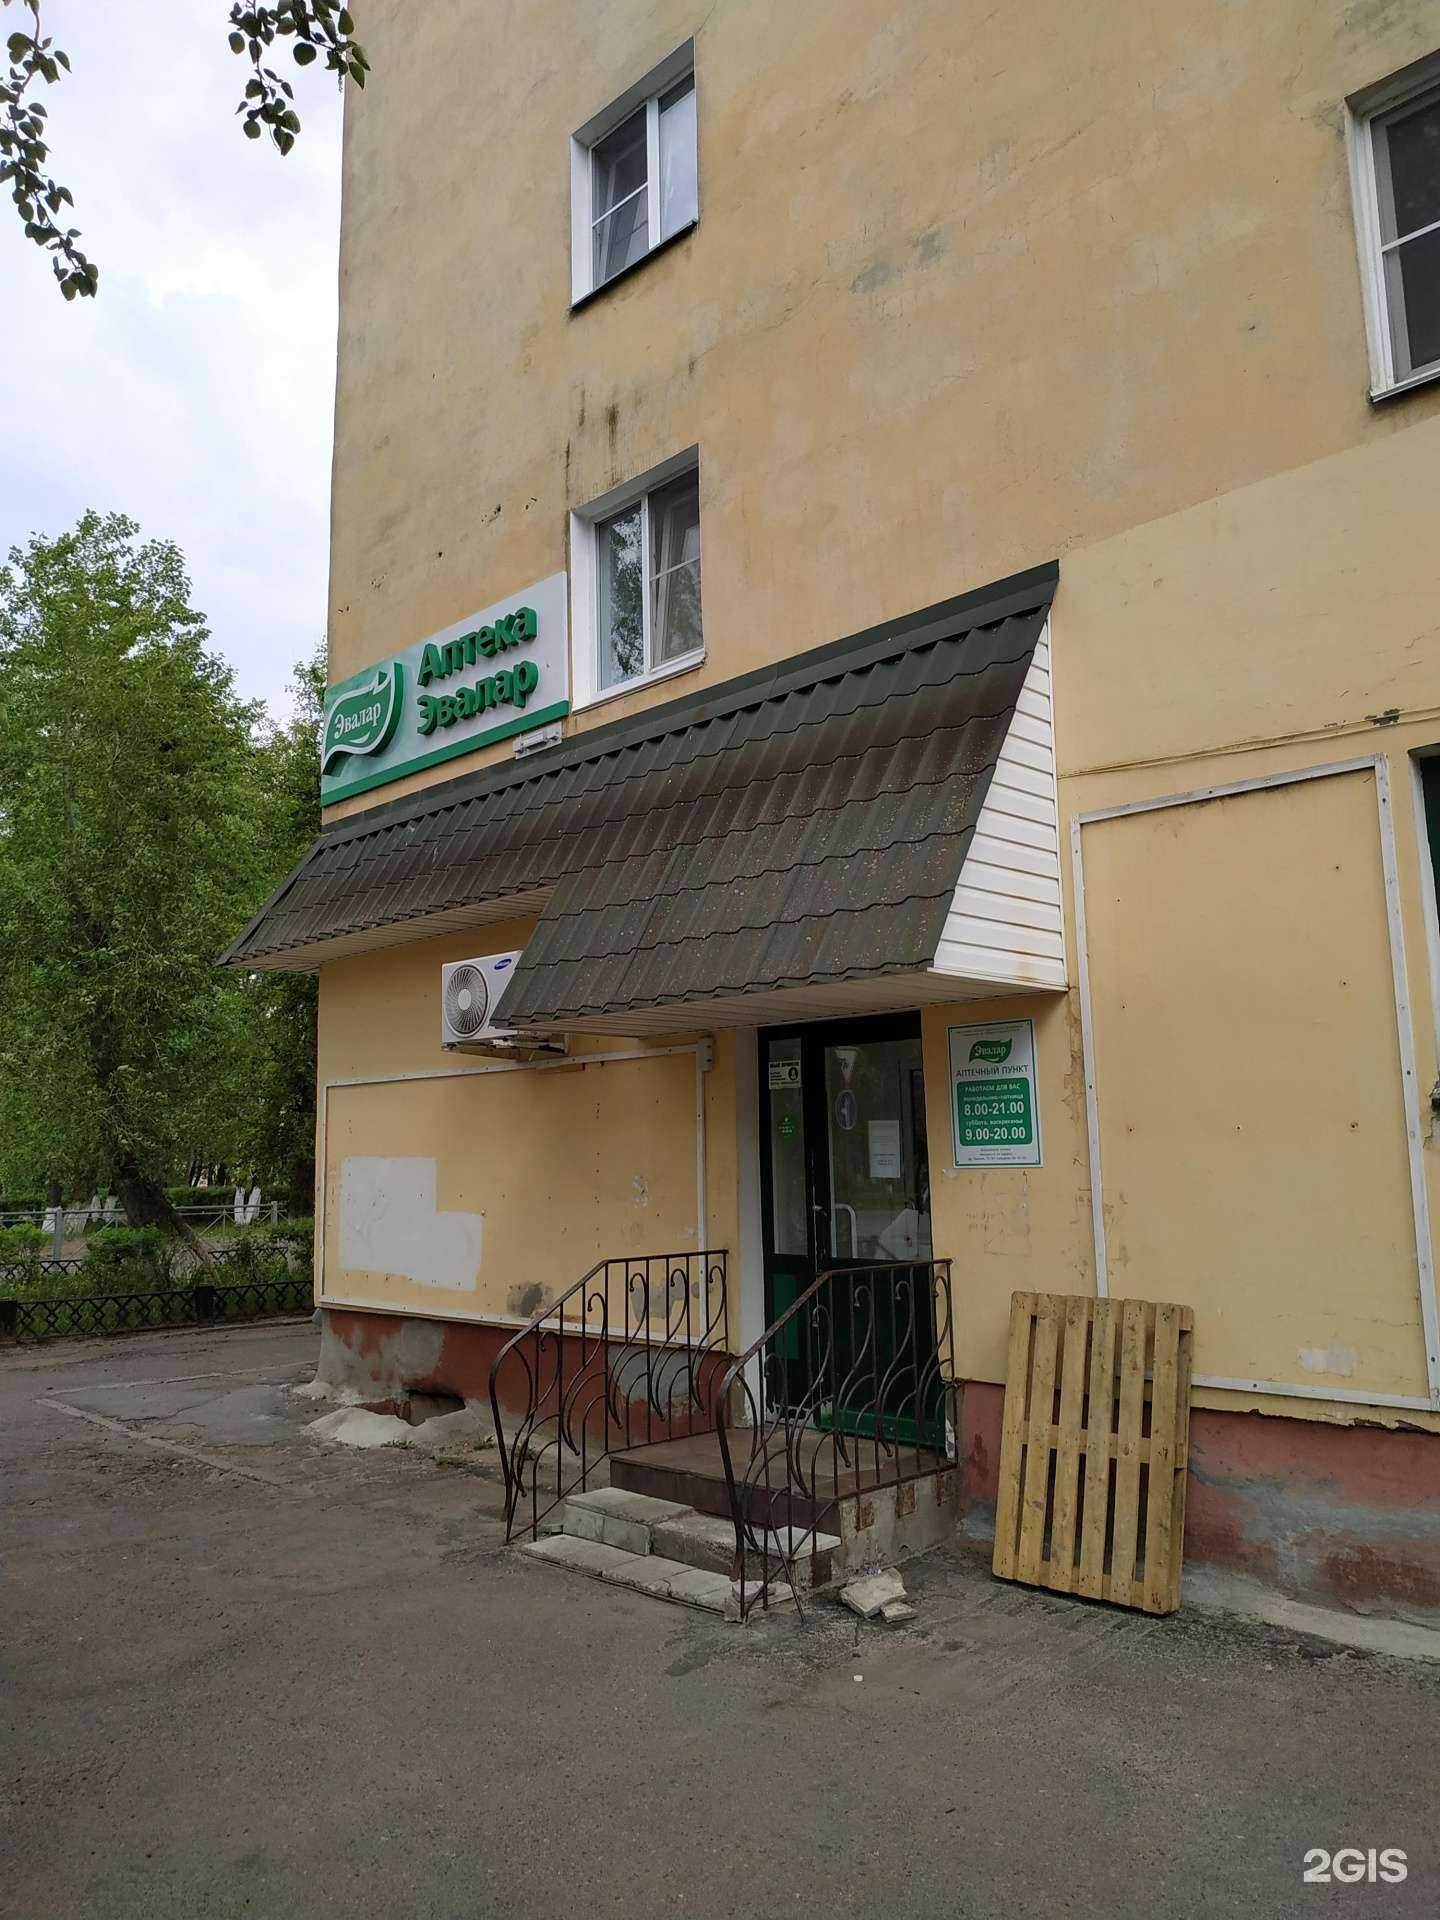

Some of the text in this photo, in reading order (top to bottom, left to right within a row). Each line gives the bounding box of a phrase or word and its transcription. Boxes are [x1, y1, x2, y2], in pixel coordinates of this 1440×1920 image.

[417, 606, 538, 687] Аптека
[417, 660, 539, 736] Эвалар
[334, 702, 381, 739] Эвалар
[974, 1045, 1007, 1057] Эвалар
[956, 1064, 1029, 1078] АПТЕЧНЫЙ ПУНКТ
[964, 1101, 1024, 1116] 8.00-21.00
[965, 1127, 1026, 1141] 9.00-20.00
